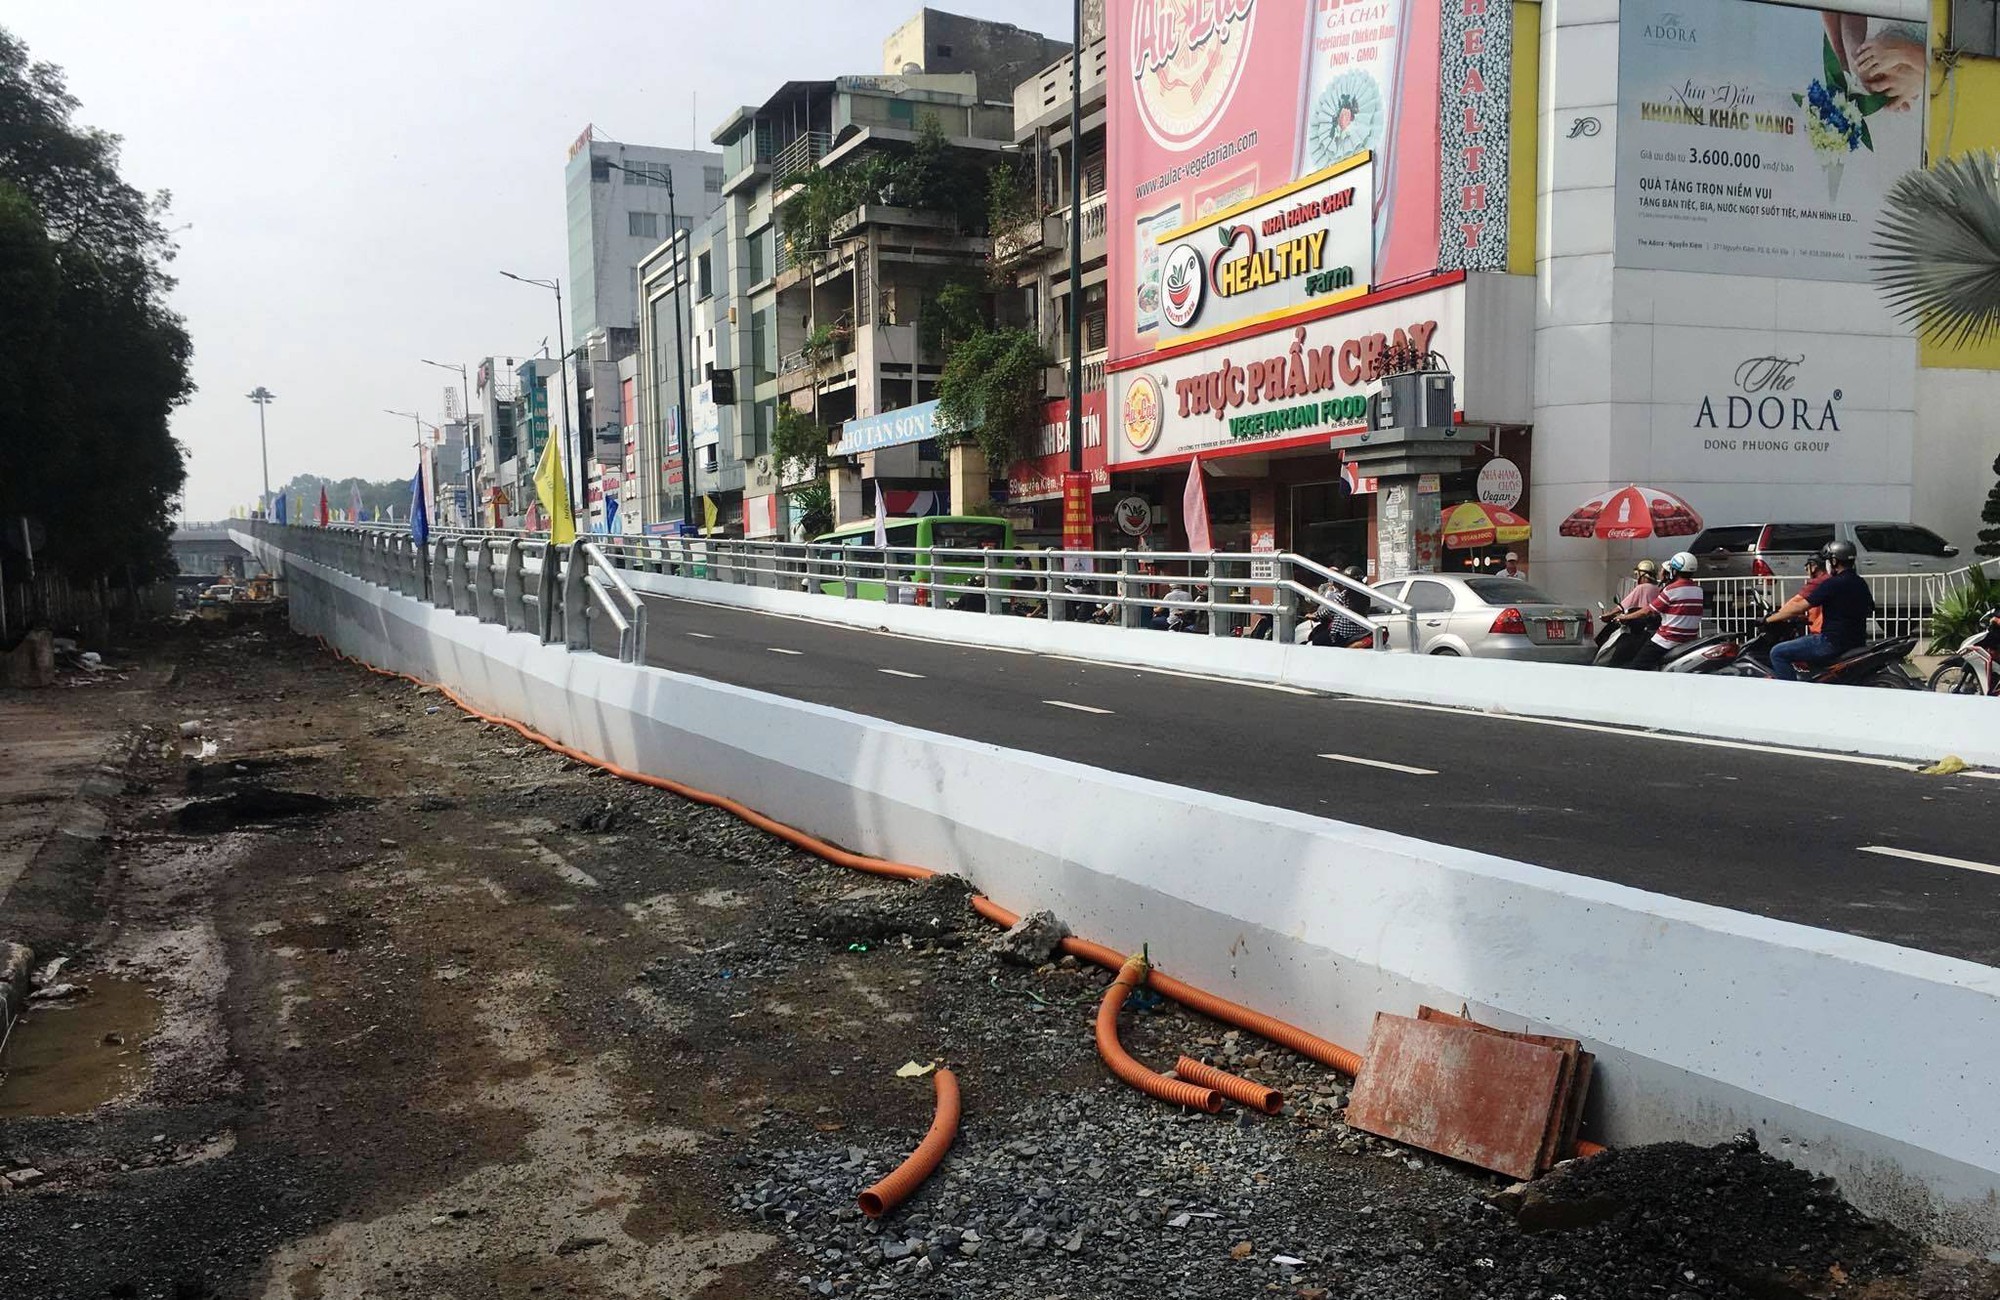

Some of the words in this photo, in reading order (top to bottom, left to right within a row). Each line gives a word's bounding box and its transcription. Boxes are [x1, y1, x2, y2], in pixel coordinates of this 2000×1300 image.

[1326, 12, 1345, 29] GÀ
[1350, 3, 1391, 24] CHAY
[1643, 24, 1696, 43] ADORA
[1709, 105, 1750, 131] KHẮC
[1755, 111, 1794, 135] VÀNG
[1135, 130, 1259, 200] www.aulac-vegetarian.com
[1689, 148, 1761, 170] 3.600.000
[1700, 202, 1716, 213] BIA,
[1755, 188, 1772, 200] VUI
[1262, 209, 1287, 237] NHÀ
[1286, 202, 1321, 229] HÀNG
[1321, 187, 1355, 215] CHAY
[1222, 229, 1328, 298] HEALTHY
[1305, 265, 1353, 296] Farm
[1175, 357, 1245, 421] THỰC
[1246, 326, 1334, 405] PHẨM
[1734, 354, 1806, 393] The
[895, 413, 925, 439] SƠN
[1081, 407, 1101, 449] TÍN
[1228, 404, 1319, 440] VEGETARIAN
[1320, 395, 1368, 426] FOOD
[1704, 439, 1737, 450] DONG
[1742, 440, 1789, 451] PHUONG
[1794, 441, 1830, 452] GROUP
[1482, 489, 1511, 504] Vegan
